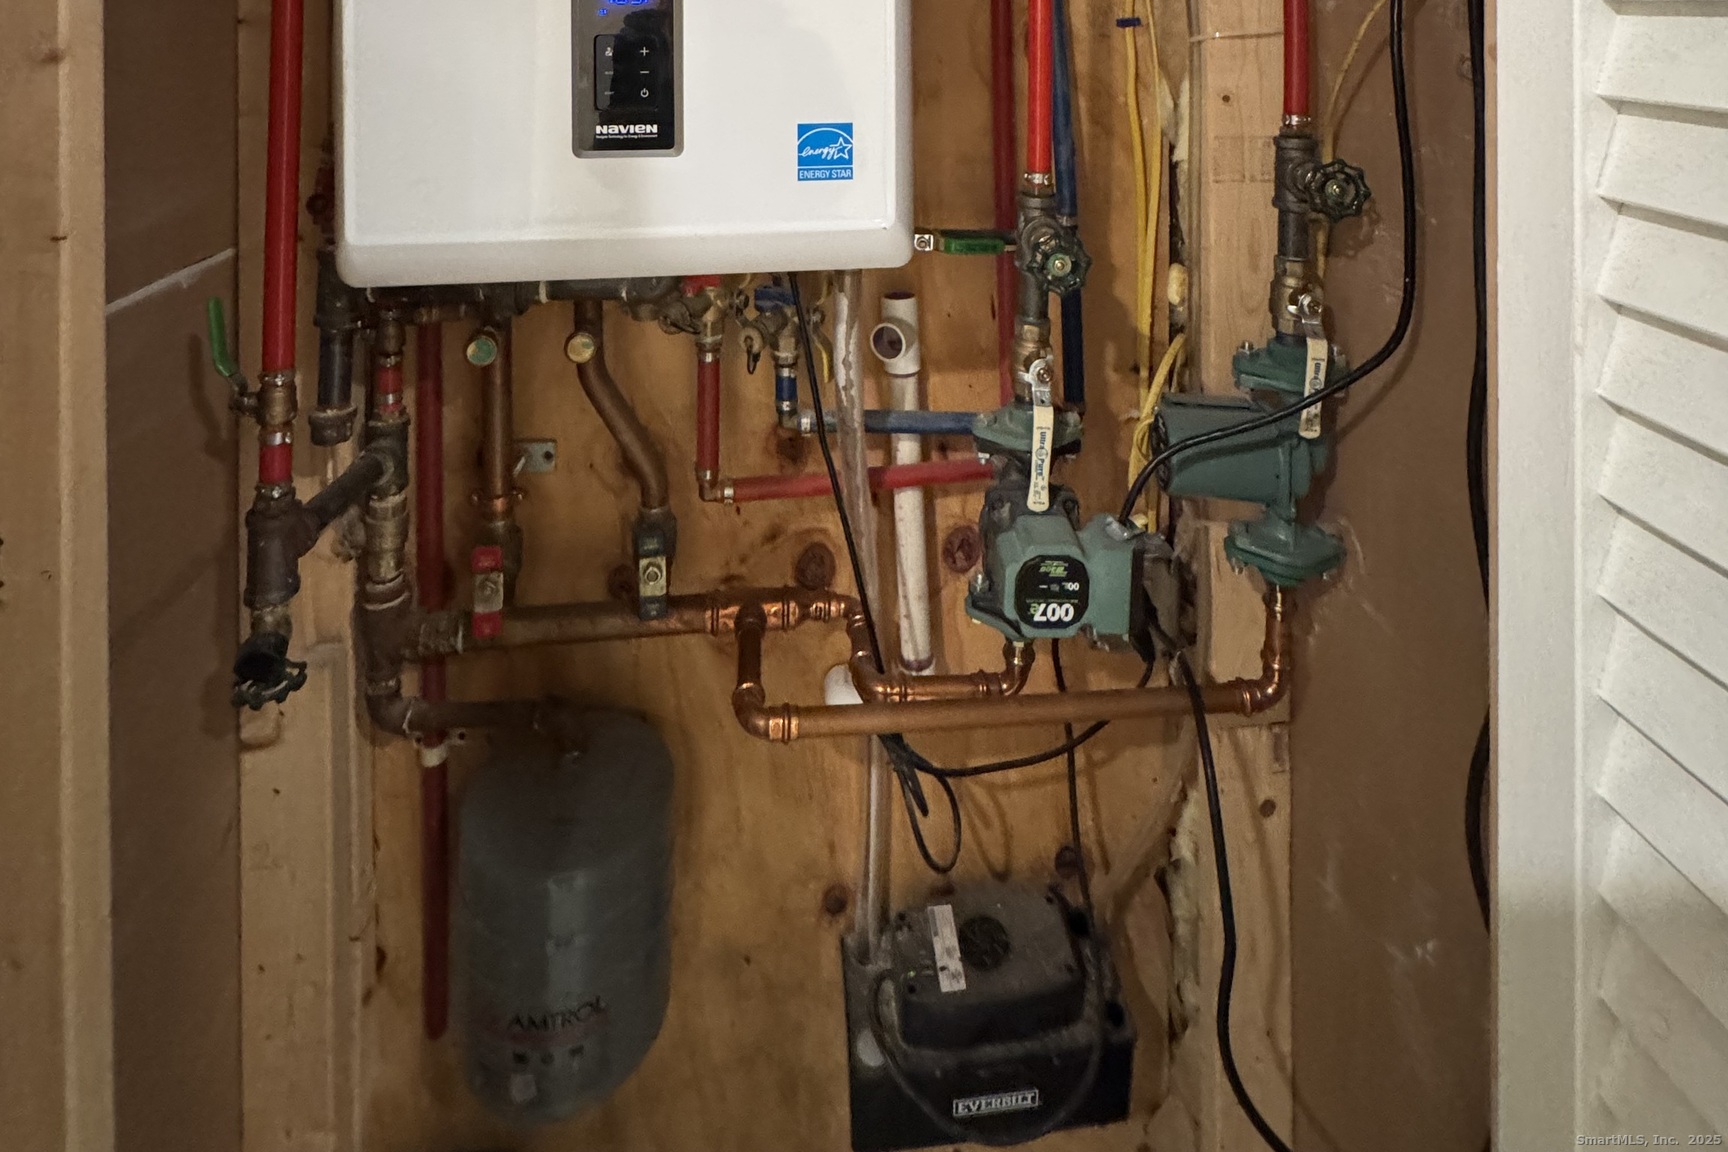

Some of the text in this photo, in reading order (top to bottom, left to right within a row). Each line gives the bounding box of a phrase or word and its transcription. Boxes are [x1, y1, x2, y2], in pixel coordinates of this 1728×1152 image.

[799, 169, 852, 179] ENERGY STAR
[956, 1091, 1036, 1115] EVERBILT
